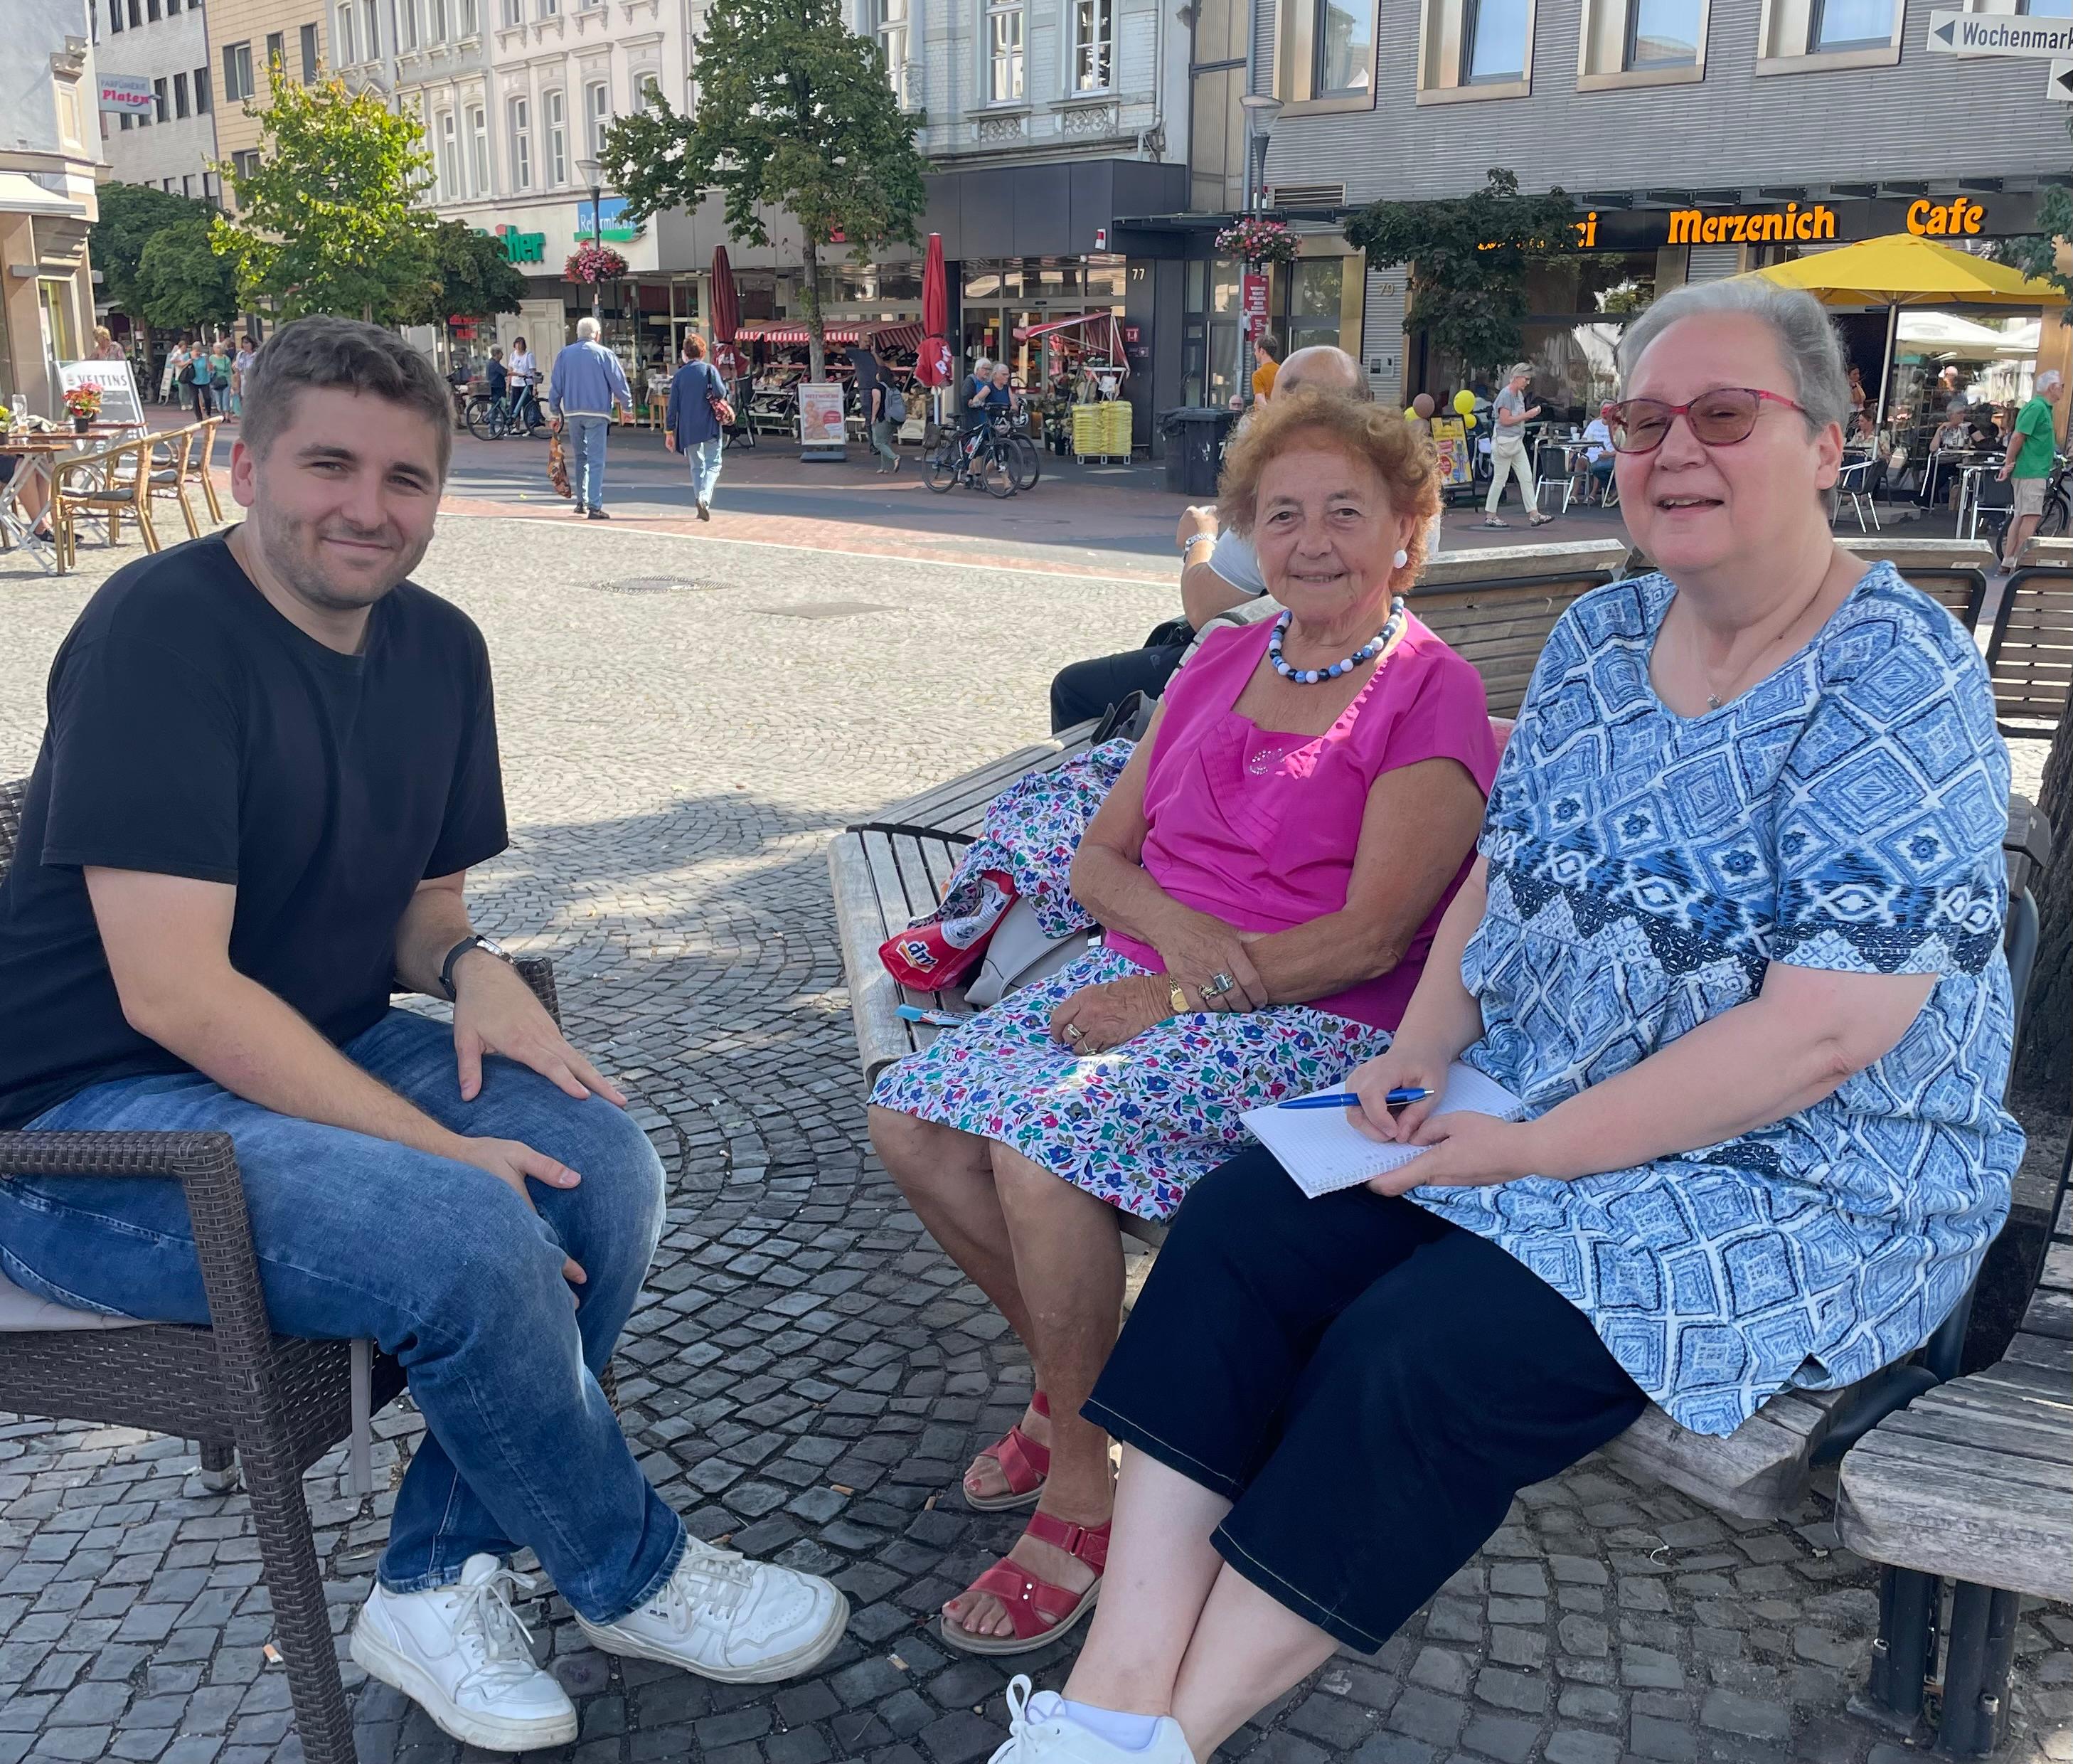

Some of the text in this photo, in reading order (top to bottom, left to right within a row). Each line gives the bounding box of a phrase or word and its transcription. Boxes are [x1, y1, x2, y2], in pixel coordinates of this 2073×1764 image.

[102, 90, 149, 105] Platen
[1907, 197, 1983, 235] Cafe
[1131, 267, 1146, 280] 77
[907, 942, 937, 966] dm
